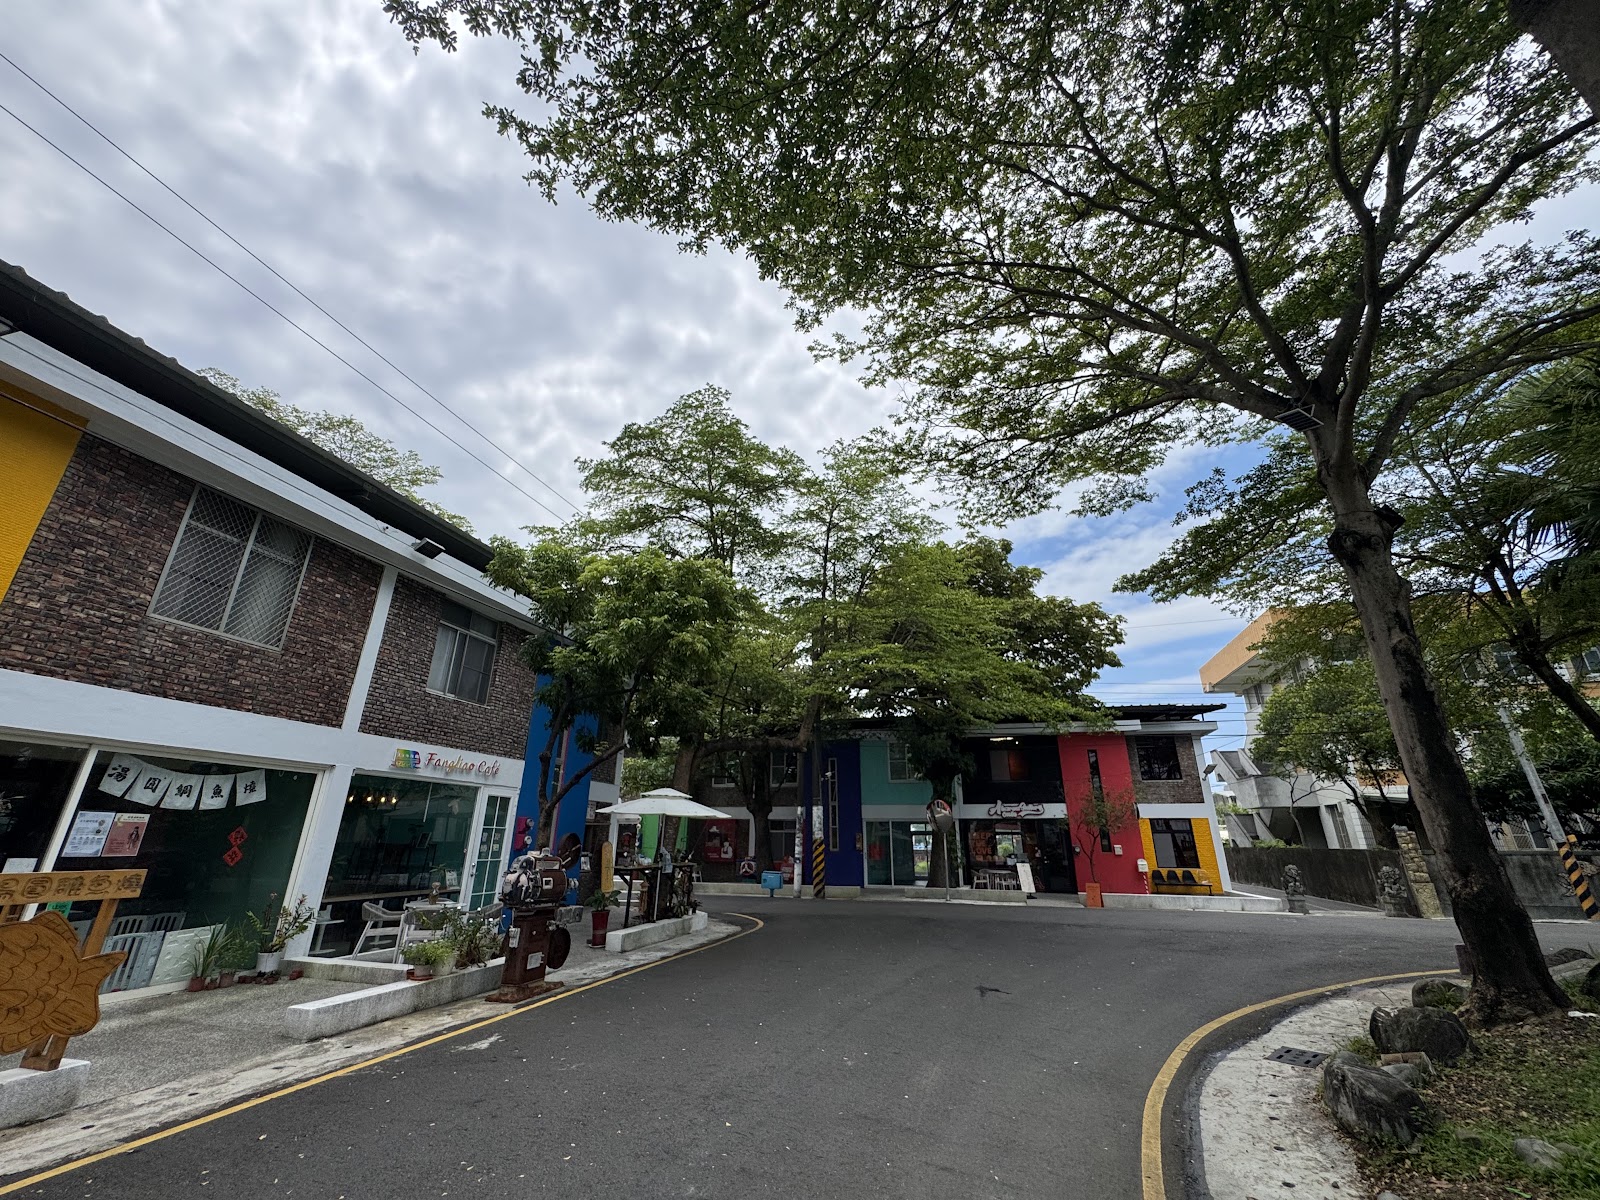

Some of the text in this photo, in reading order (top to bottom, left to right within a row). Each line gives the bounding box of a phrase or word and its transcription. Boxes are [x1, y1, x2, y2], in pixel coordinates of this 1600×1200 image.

[426, 753, 501, 776] Fangliao Café
[107, 764, 257, 800] 湯圓鯛魚燒
